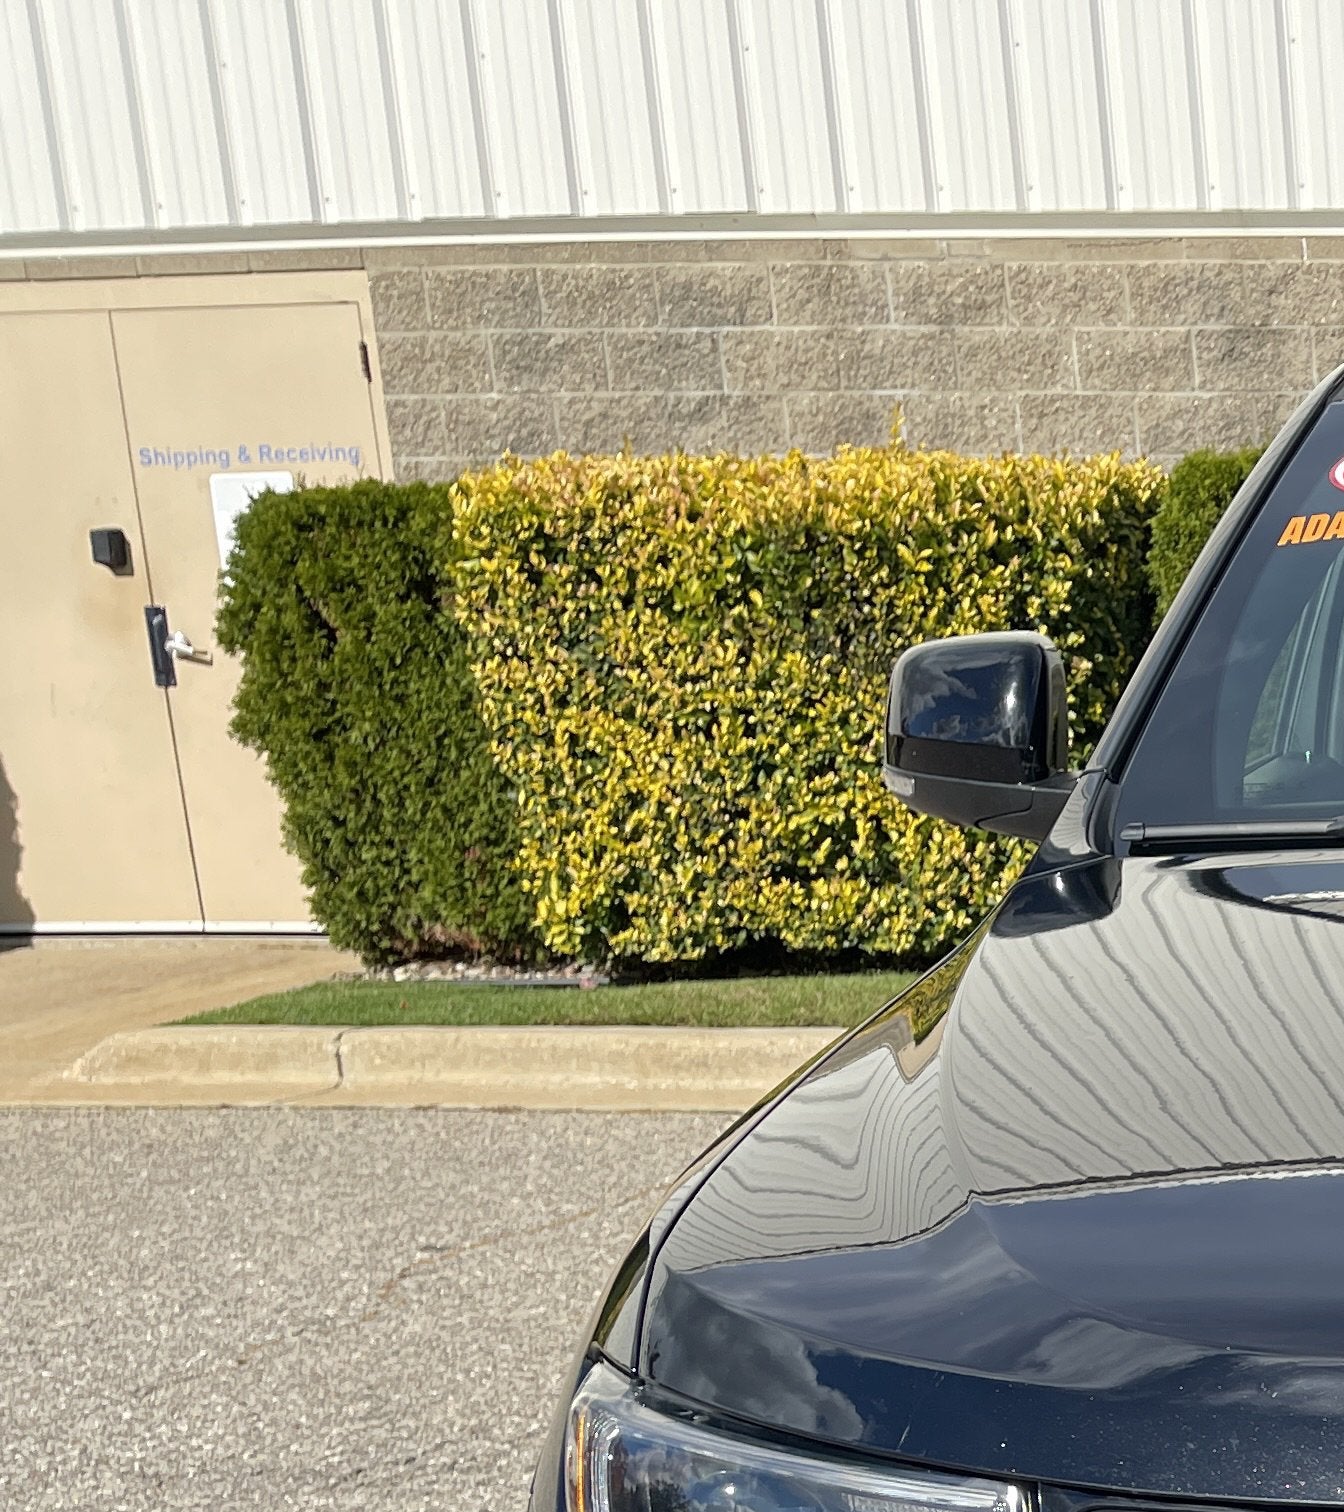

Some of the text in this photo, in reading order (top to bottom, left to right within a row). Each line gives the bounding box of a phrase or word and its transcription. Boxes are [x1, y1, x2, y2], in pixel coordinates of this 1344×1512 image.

[139, 441, 360, 469] Shipping & Receiving
